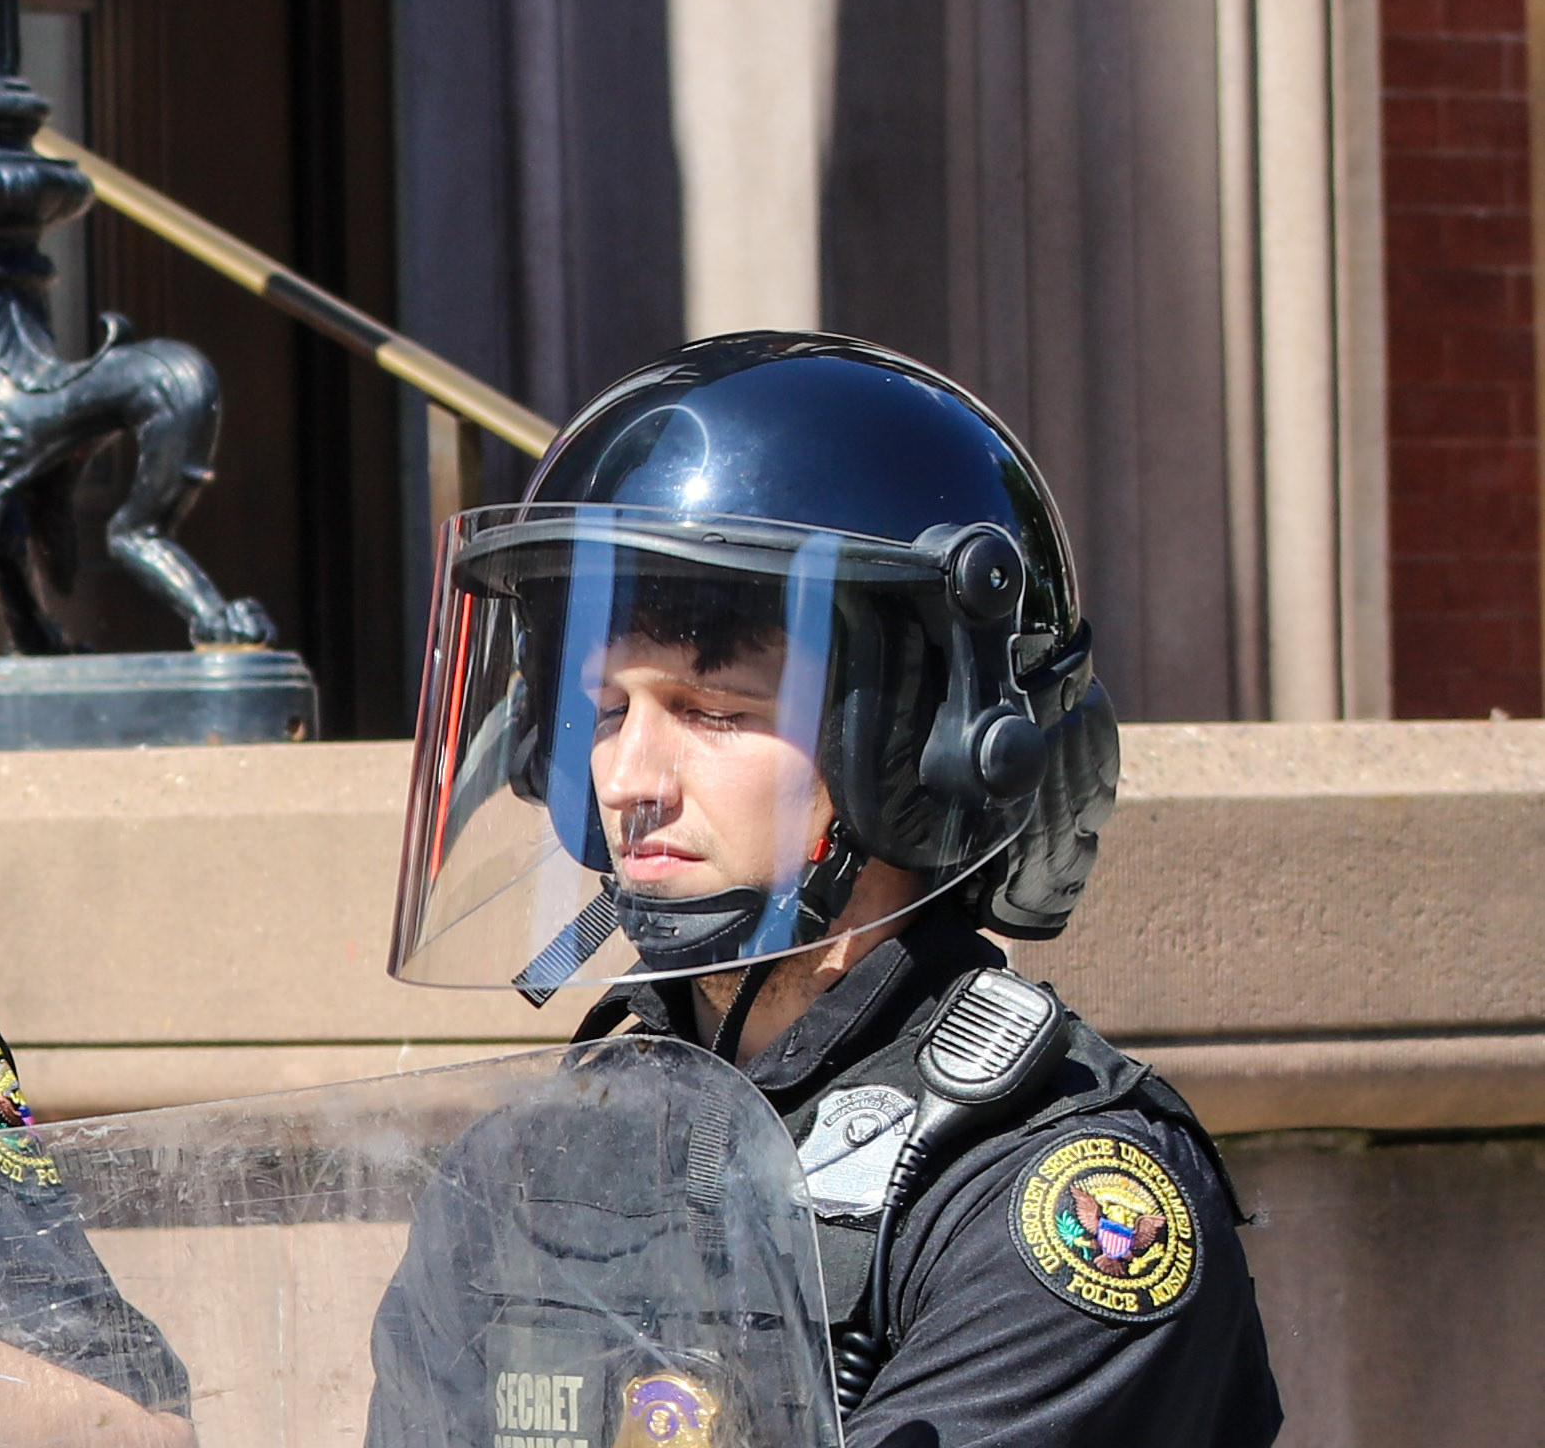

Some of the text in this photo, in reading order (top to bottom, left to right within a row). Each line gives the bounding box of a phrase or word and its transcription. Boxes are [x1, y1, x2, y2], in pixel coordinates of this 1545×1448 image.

[1038, 1138, 1114, 1180] SERVICE
[1119, 1142, 1192, 1239] UNIFORMED
[1021, 1176, 1049, 1244] SECRET
[1066, 1274, 1139, 1312] POLICE
[1149, 1241, 1193, 1306] DIVISION
[495, 1371, 584, 1432] SECRET
